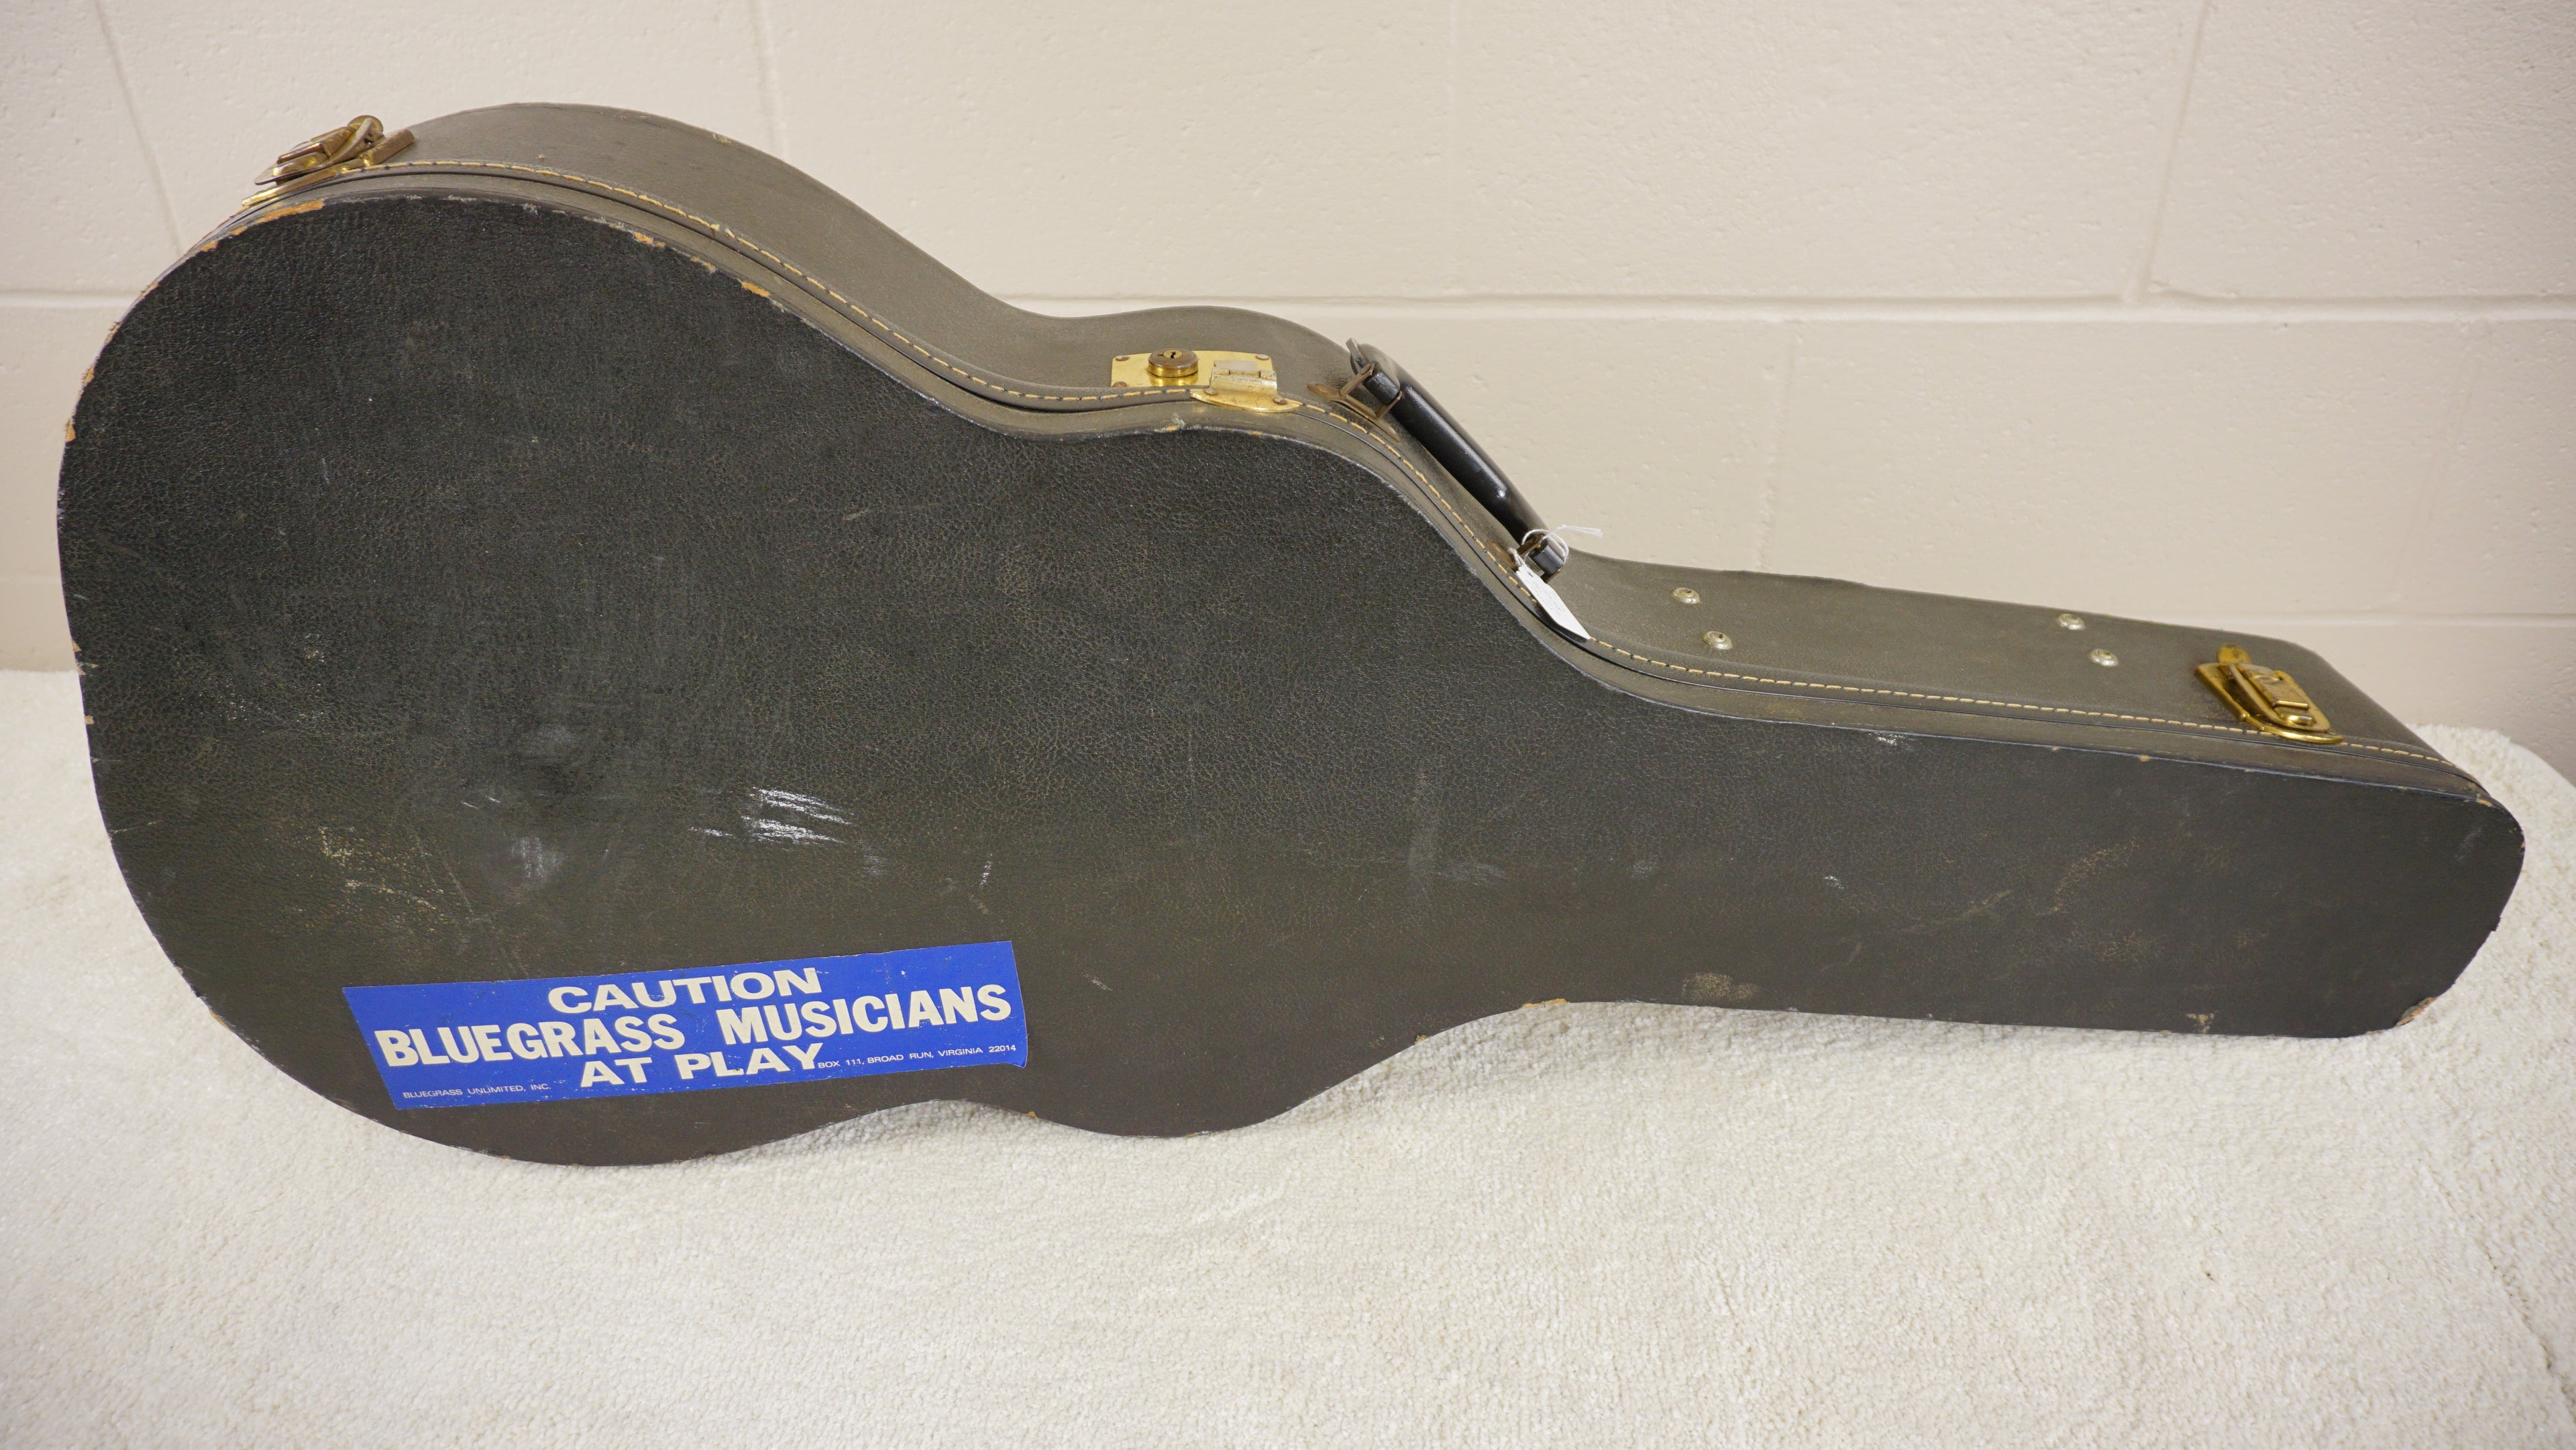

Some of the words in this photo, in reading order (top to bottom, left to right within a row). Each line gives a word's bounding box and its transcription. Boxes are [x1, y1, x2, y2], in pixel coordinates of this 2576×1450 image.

[548, 967, 822, 1014] CAUTION
[374, 1013, 686, 1068] BLUEGRASS
[716, 984, 1012, 1045] MUSICIANS
[580, 1057, 653, 1088] AT
[674, 1042, 824, 1080] PLAY
[818, 1061, 841, 1069] BOX
[867, 1053, 904, 1064] BROAD
[909, 1051, 934, 1059] RUN,
[938, 1047, 983, 1057] VIRGINIA
[988, 1044, 1017, 1053] 22014
[402, 1088, 464, 1099] BLUEGRASS
[467, 1084, 527, 1095] UNLIMITED,
[530, 1082, 552, 1091] INC.
